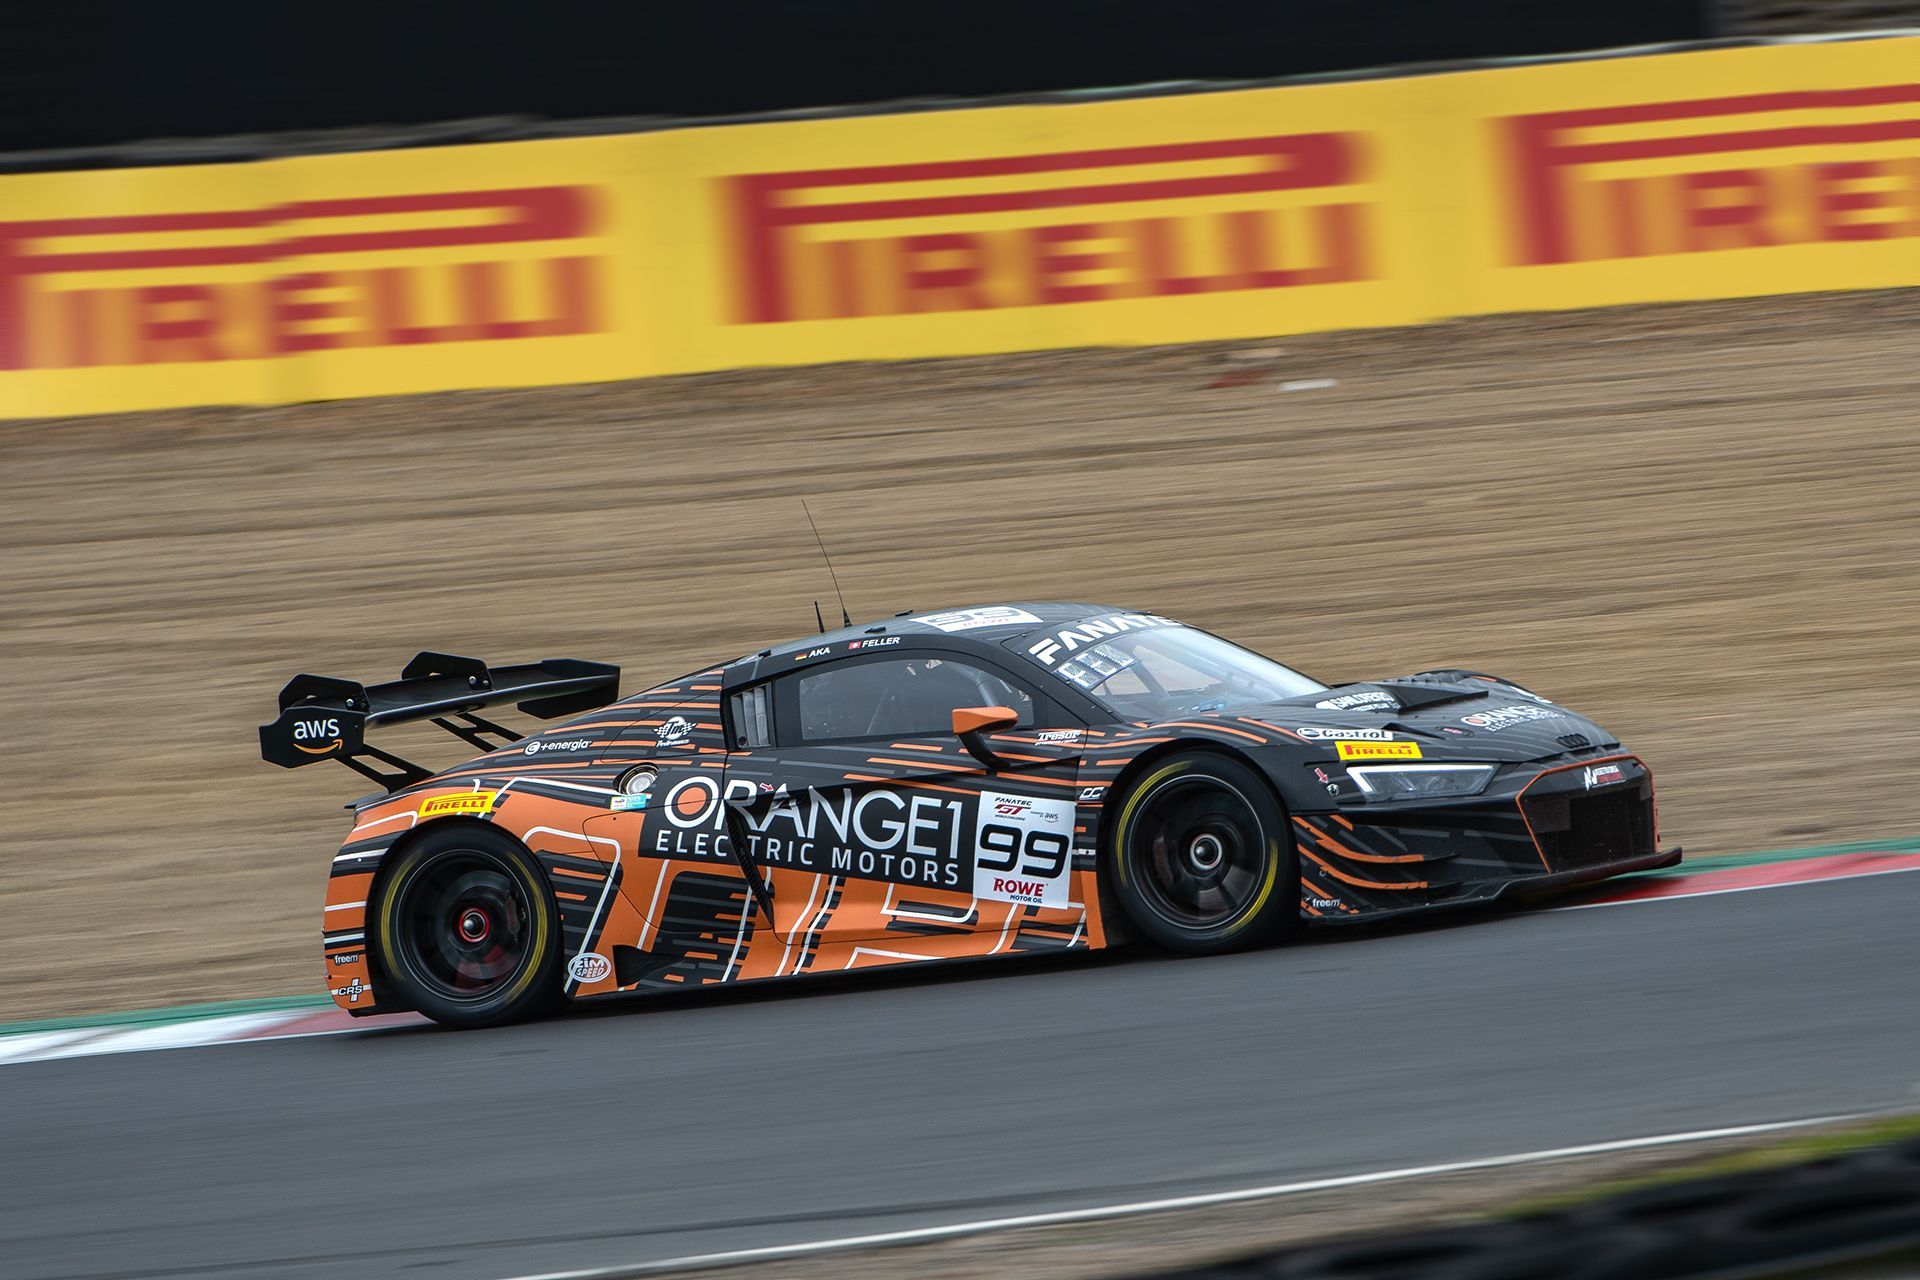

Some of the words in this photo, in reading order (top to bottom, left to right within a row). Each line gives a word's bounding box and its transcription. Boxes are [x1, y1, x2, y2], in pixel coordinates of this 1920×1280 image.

[1488, 83, 1920, 266] PIRE
[717, 131, 1373, 324] PIRELLI
[862, 637, 900, 648] FELLER
[1028, 614, 1184, 666] FANATE
[809, 647, 830, 658] AKA
[294, 719, 340, 739] aws
[1322, 730, 1389, 739] Castrol
[1344, 744, 1413, 755] PIRELLI
[425, 796, 488, 812] PIRELLI
[995, 797, 1031, 806] FANATEC
[664, 776, 963, 859] ORANGE1
[656, 830, 814, 865] ELECTRIC
[832, 847, 959, 885] MOTORS
[977, 823, 1070, 879] 99
[993, 878, 1044, 896] ROWE
[1312, 899, 1340, 907] freem
[335, 955, 358, 964] freem
[576, 967, 605, 978] SPEED
[339, 986, 363, 996] CRS
